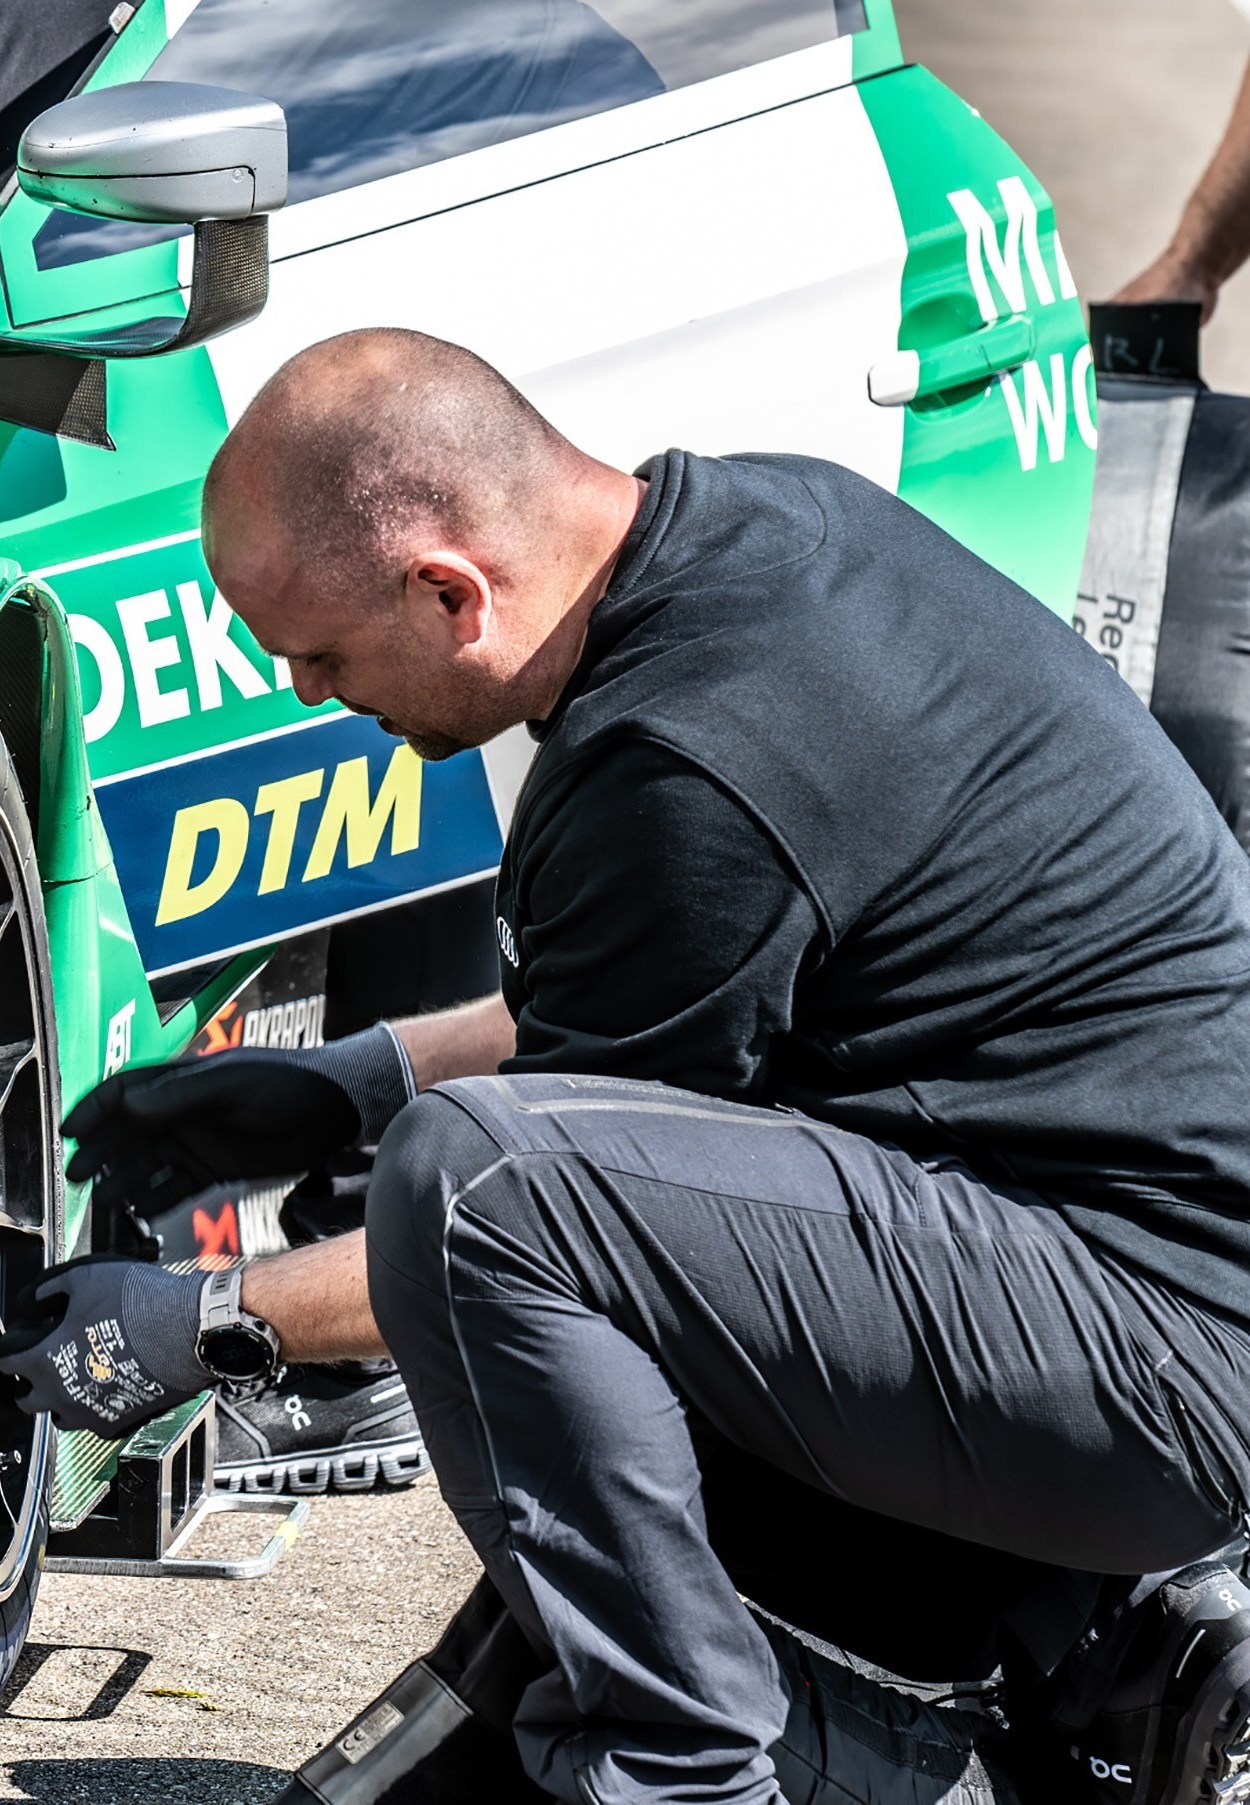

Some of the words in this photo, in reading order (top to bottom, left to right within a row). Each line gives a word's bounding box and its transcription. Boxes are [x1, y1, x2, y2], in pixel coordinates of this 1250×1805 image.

[66, 579, 292, 745] DEK
[154, 741, 424, 928] DTM
[103, 998, 137, 1081] ABT
